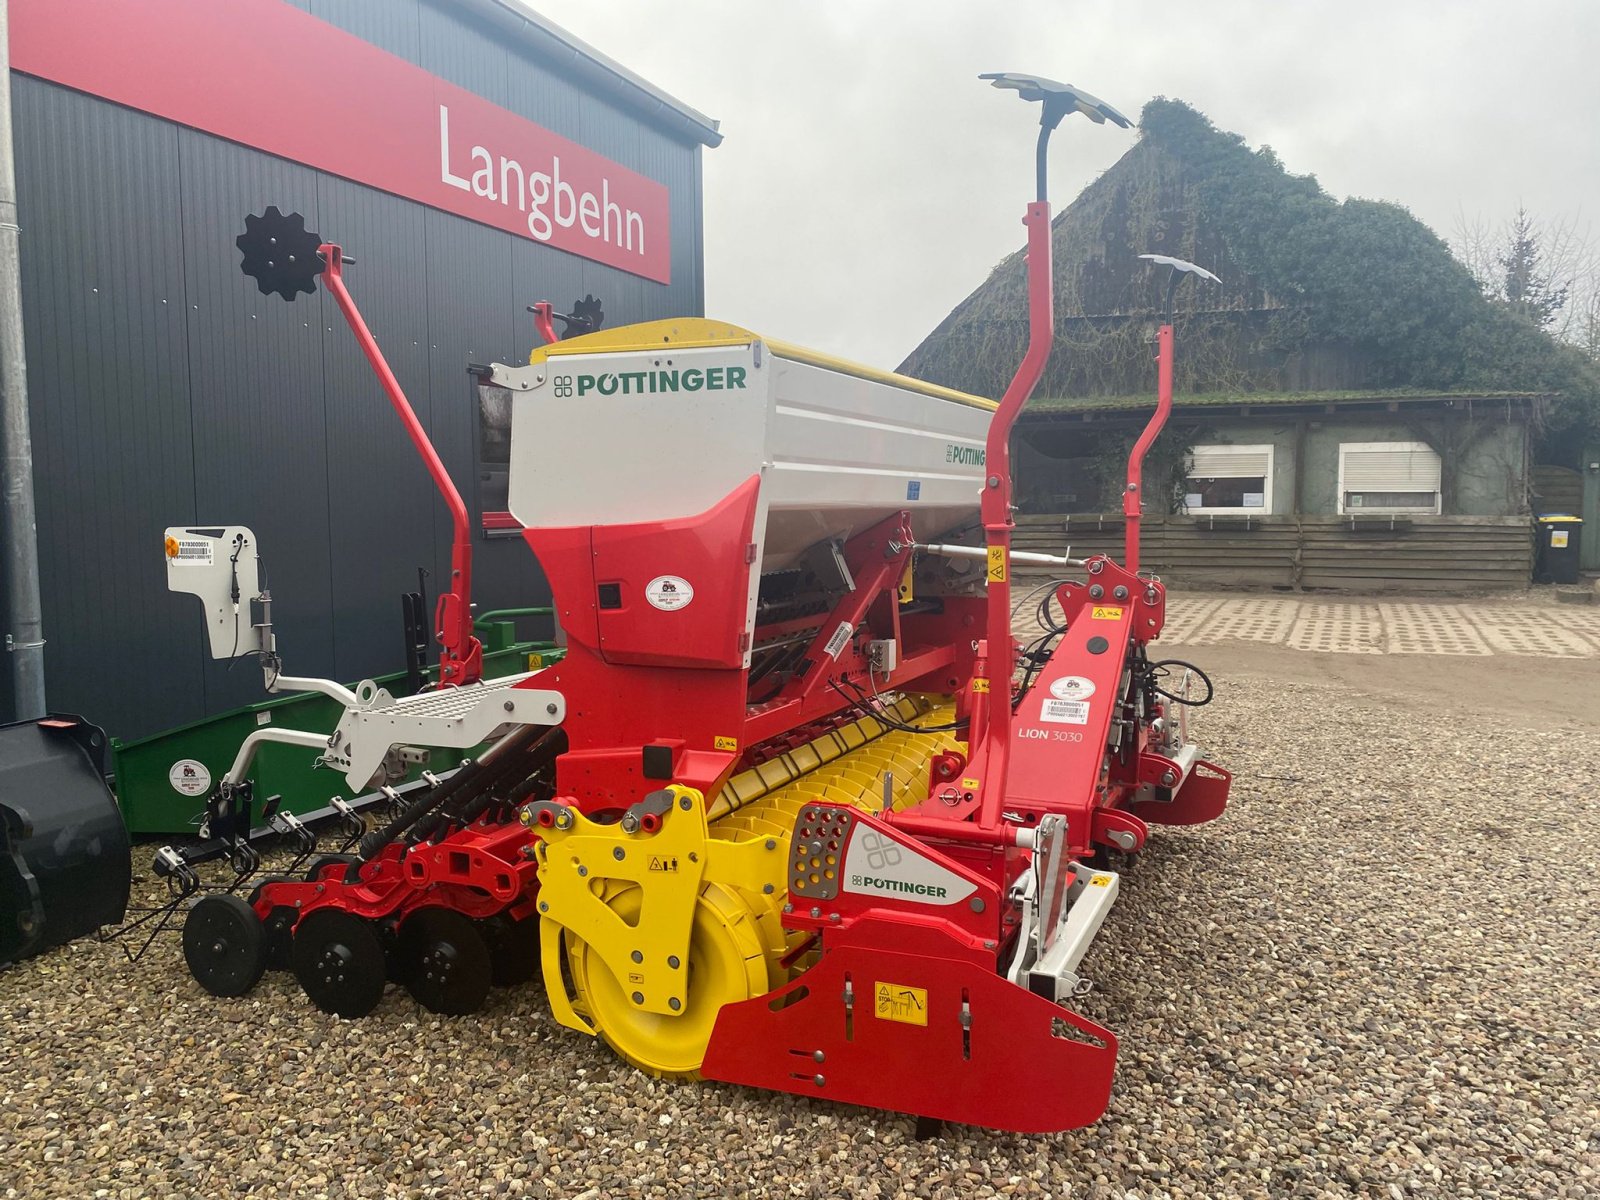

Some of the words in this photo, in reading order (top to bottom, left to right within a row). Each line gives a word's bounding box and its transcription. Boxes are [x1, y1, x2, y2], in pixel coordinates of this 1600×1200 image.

[440, 104, 645, 255] Langbehn
[1018, 728, 1049, 739] LION
[1051, 731, 1083, 743] 3030
